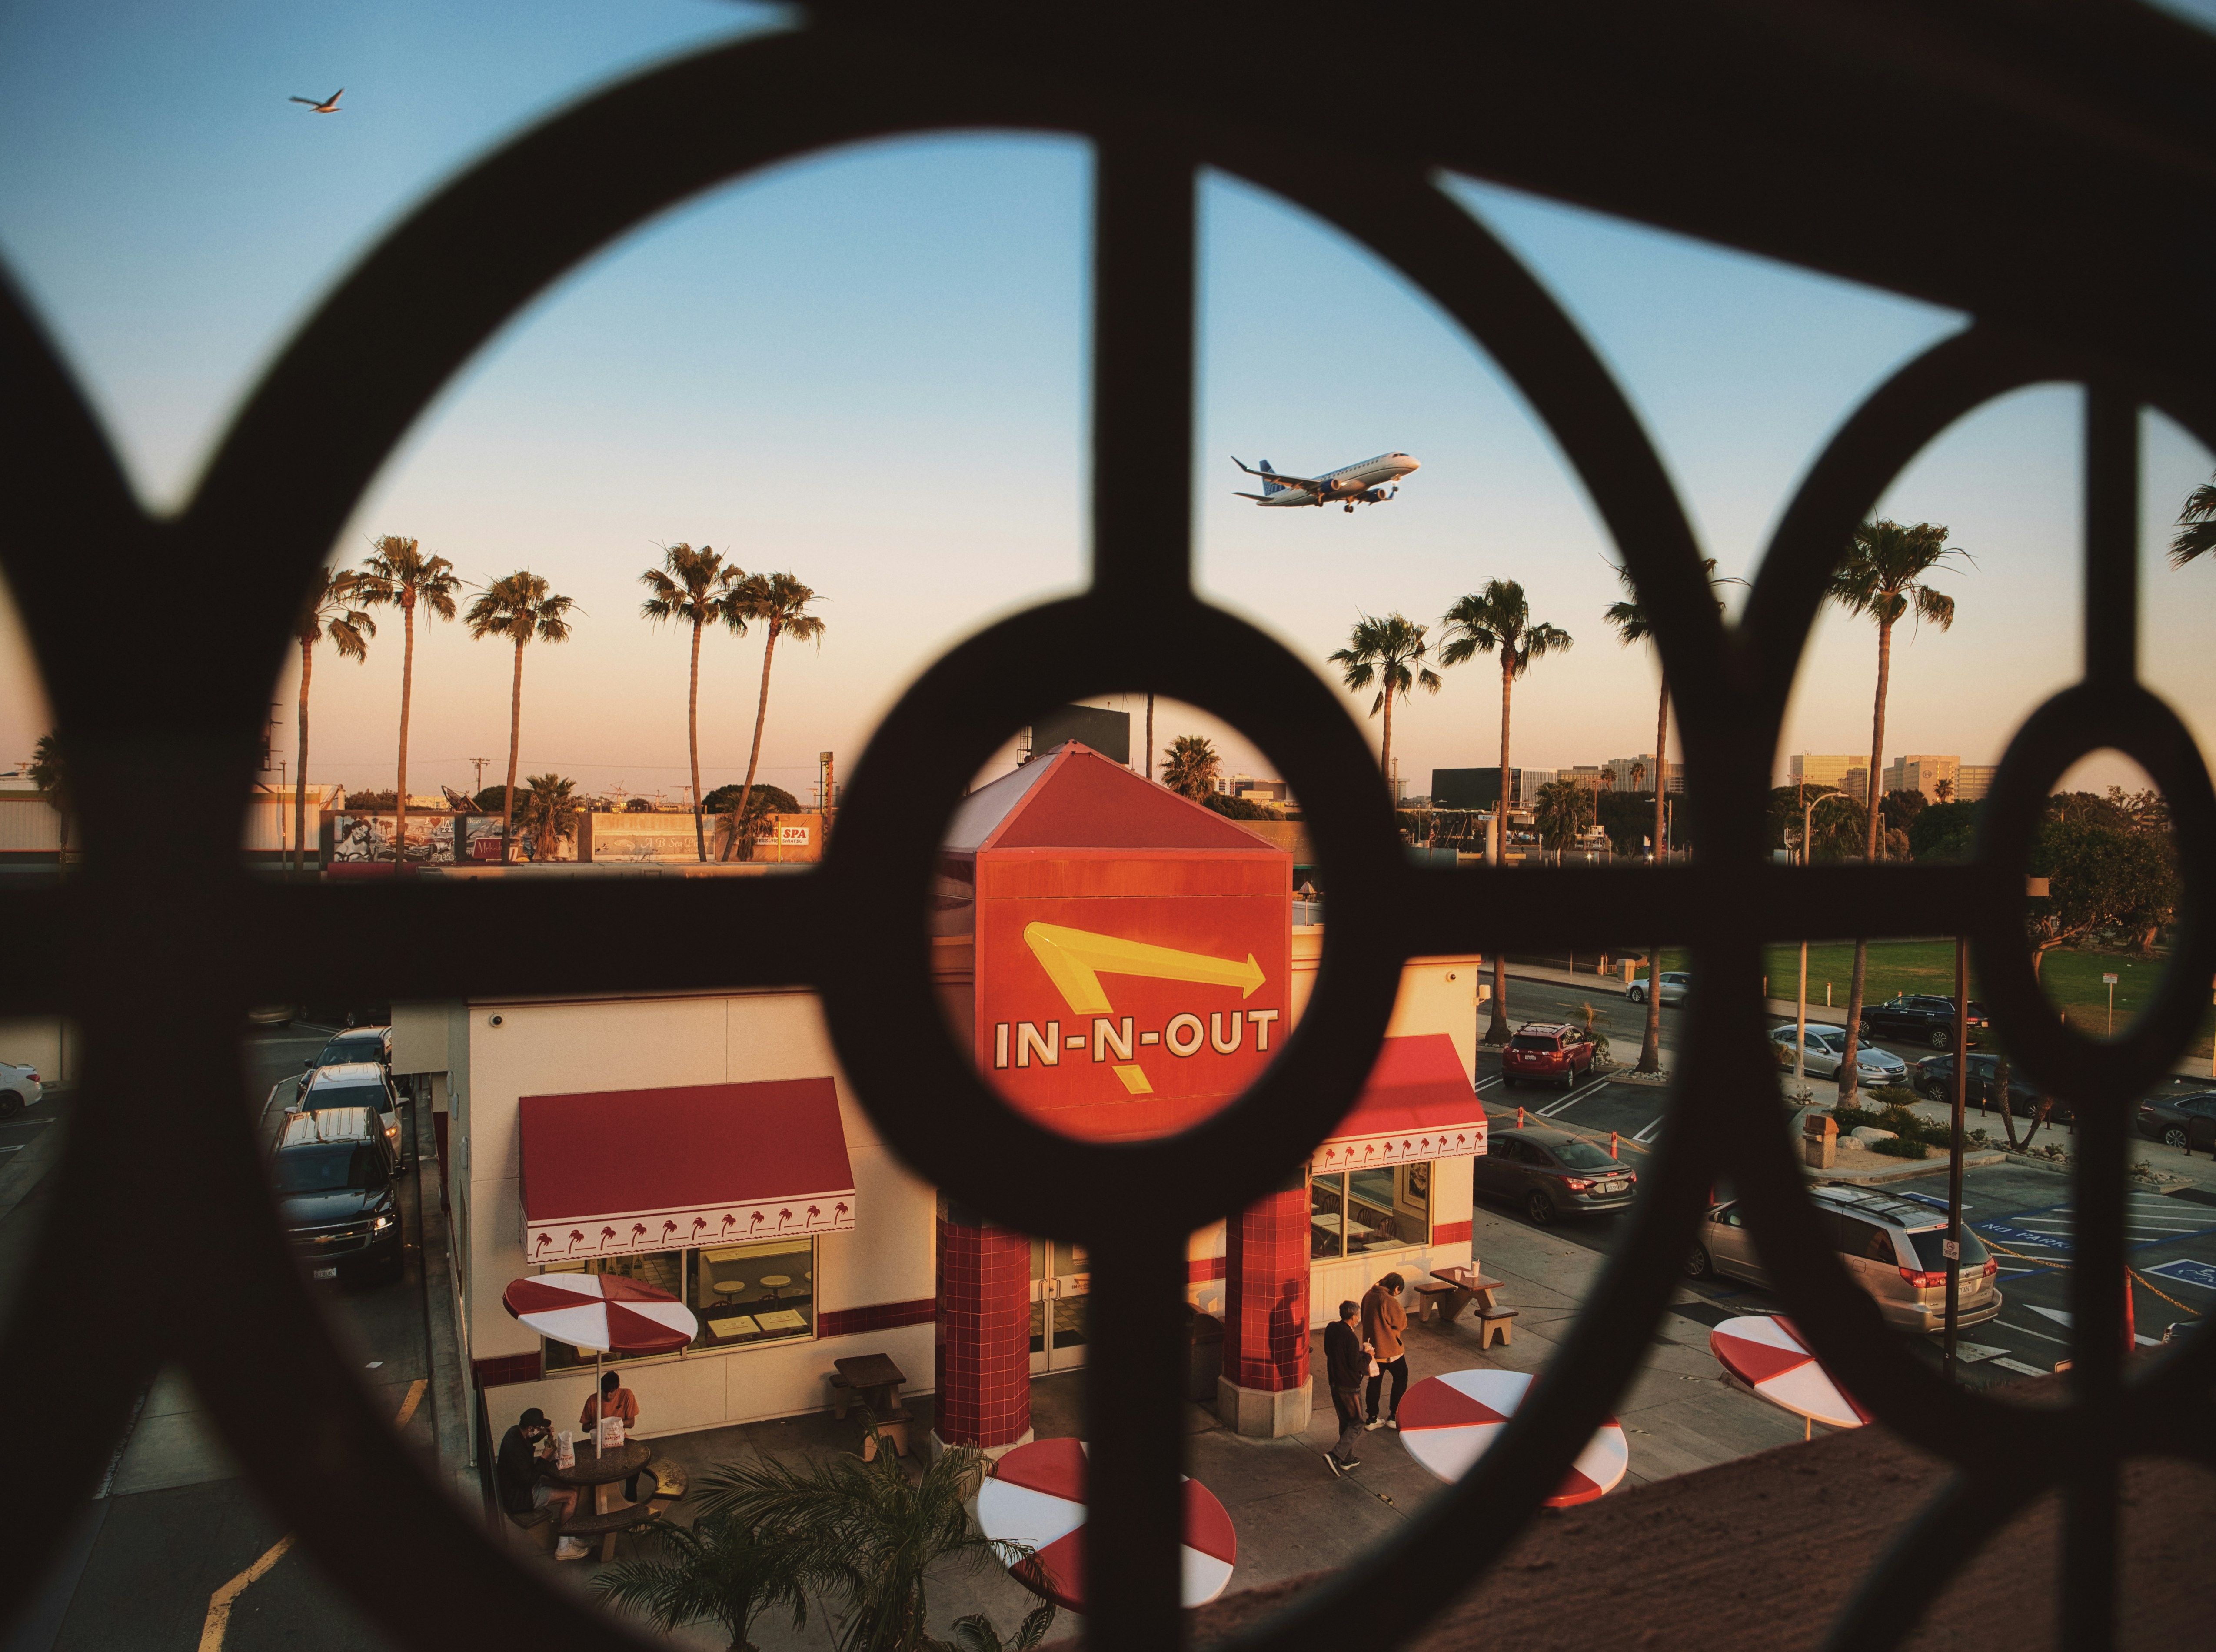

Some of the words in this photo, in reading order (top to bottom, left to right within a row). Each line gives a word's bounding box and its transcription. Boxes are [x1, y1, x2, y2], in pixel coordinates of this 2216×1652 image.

[424, 816, 431, 825] I
[440, 816, 453, 833] LA
[783, 829, 806, 838] SPA
[641, 837, 653, 848] A
[655, 837, 665, 847] B
[668, 837, 682, 847] Sea
[685, 837, 708, 847] Pho
[994, 1009, 1279, 1069] IN-N-OUT
[1982, 1224, 2012, 1232] NO
